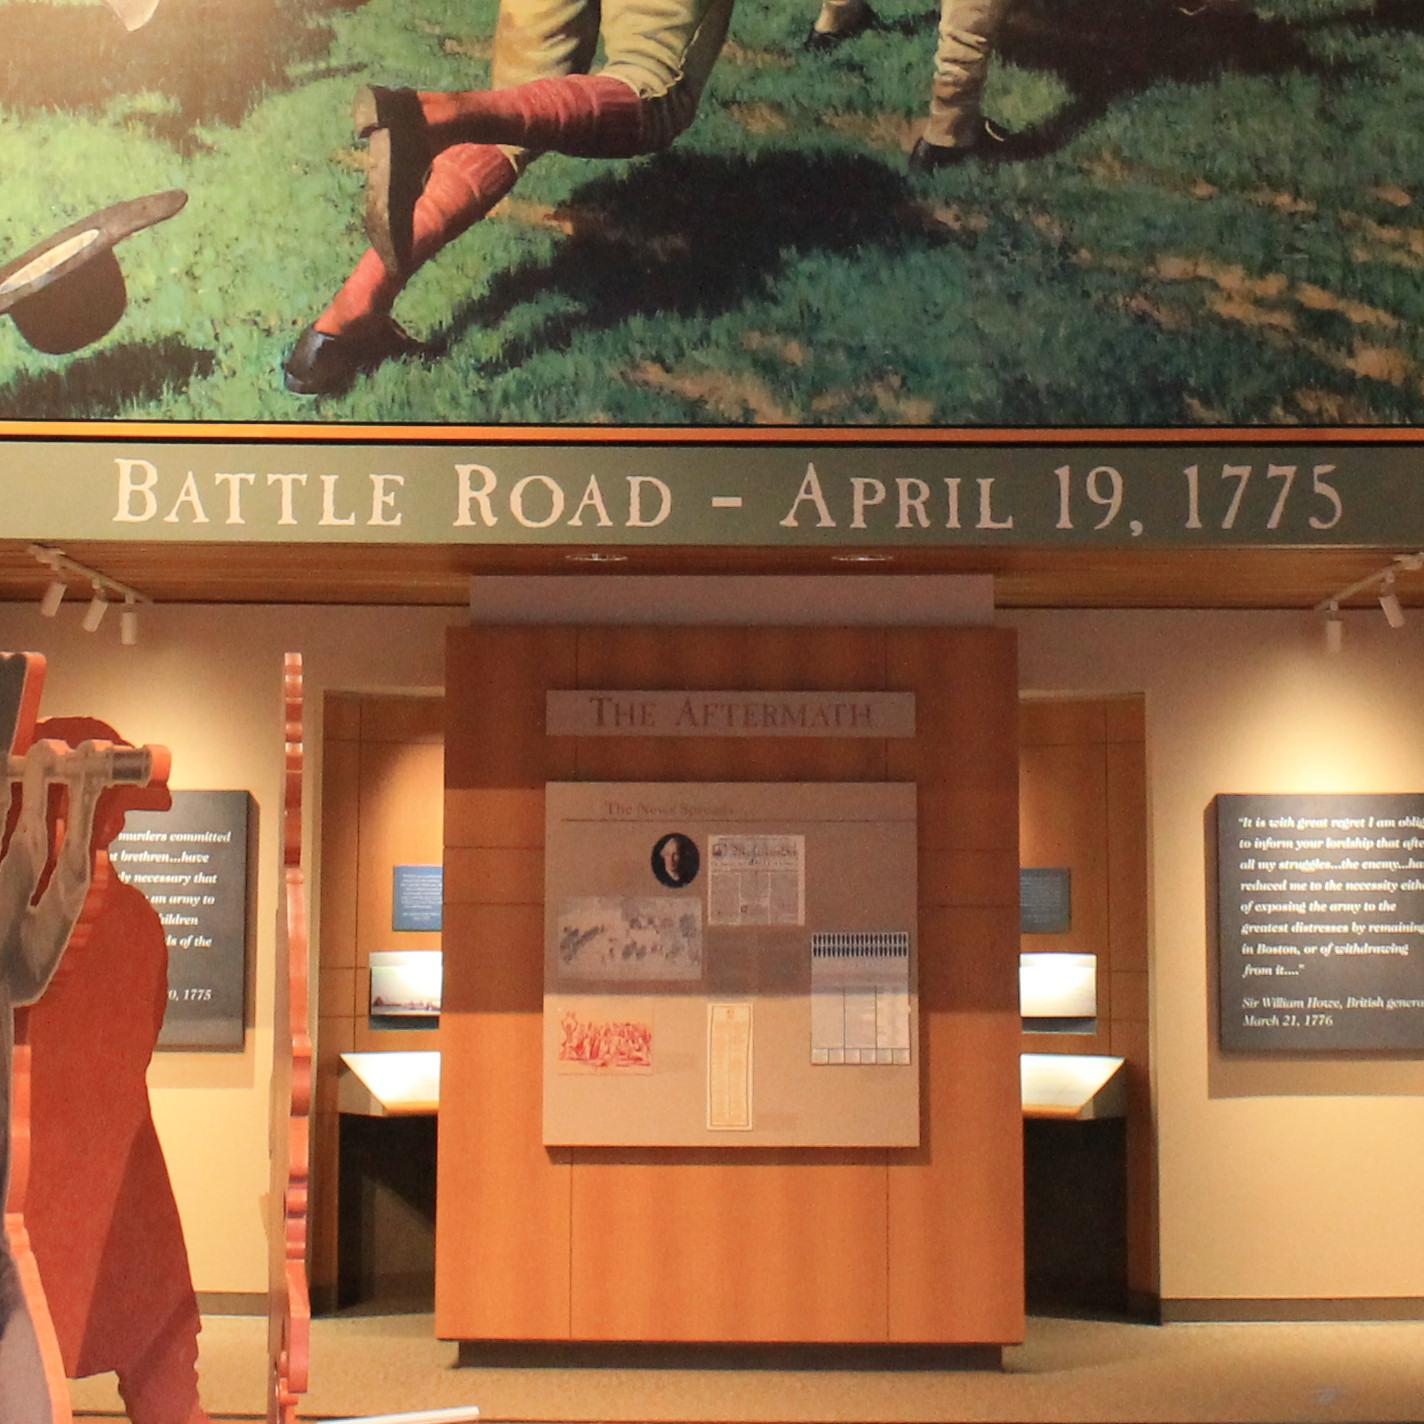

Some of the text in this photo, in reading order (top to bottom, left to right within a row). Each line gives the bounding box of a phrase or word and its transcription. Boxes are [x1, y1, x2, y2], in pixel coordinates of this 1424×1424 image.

[112, 458, 404, 527] BATTLE
[452, 463, 672, 528] ROAD
[779, 461, 1013, 528] APRIL
[1054, 464, 1144, 536] 19,
[1183, 463, 1343, 529] 1775
[589, 697, 874, 727] THE AFTERMATH
[1256, 817, 1265, 828] is
[1269, 817, 1295, 828] with
[1296, 818, 1328, 831] great
[1331, 817, 1364, 831] regret
[1368, 817, 1374, 828] I
[1377, 819, 1395, 828] am
[118, 830, 231, 843] murders committed
[1239, 839, 1251, 849] to
[1254, 838, 1293, 851] inform
[1295, 839, 1324, 851] your
[1326, 838, 1374, 851] lordship
[1377, 838, 1400, 849] that
[1239, 859, 1254, 870] all
[1258, 861, 1275, 872] my
[134, 874, 191, 885] necessary
[193, 873, 217, 884] that
[1240, 880, 1287, 892] reduced
[1289, 882, 1307, 892] me
[1310, 881, 1322, 891] to
[1324, 880, 1343, 891] the
[1345, 880, 1398, 893] necessity
[151, 894, 215, 907] an army to
[1240, 900, 1396, 915] of exposing the army to the
[1241, 922, 1289, 935] greatest
[1291, 922, 1348, 934] distresses
[1352, 922, 1366, 935] by
[180, 935, 193, 949] of
[194, 934, 212, 948] the
[1242, 942, 1409, 957] in Boston, or of withdrawing
[1242, 964, 1273, 978] from
[184, 989, 212, 1000] 1775
[1242, 997, 1258, 1009] Sir
[1262, 997, 1304, 1009] William
[1307, 997, 1343, 1009] Howe,
[1346, 997, 1384, 1009] British
[1242, 1015, 1333, 1027] March 21, 1776
